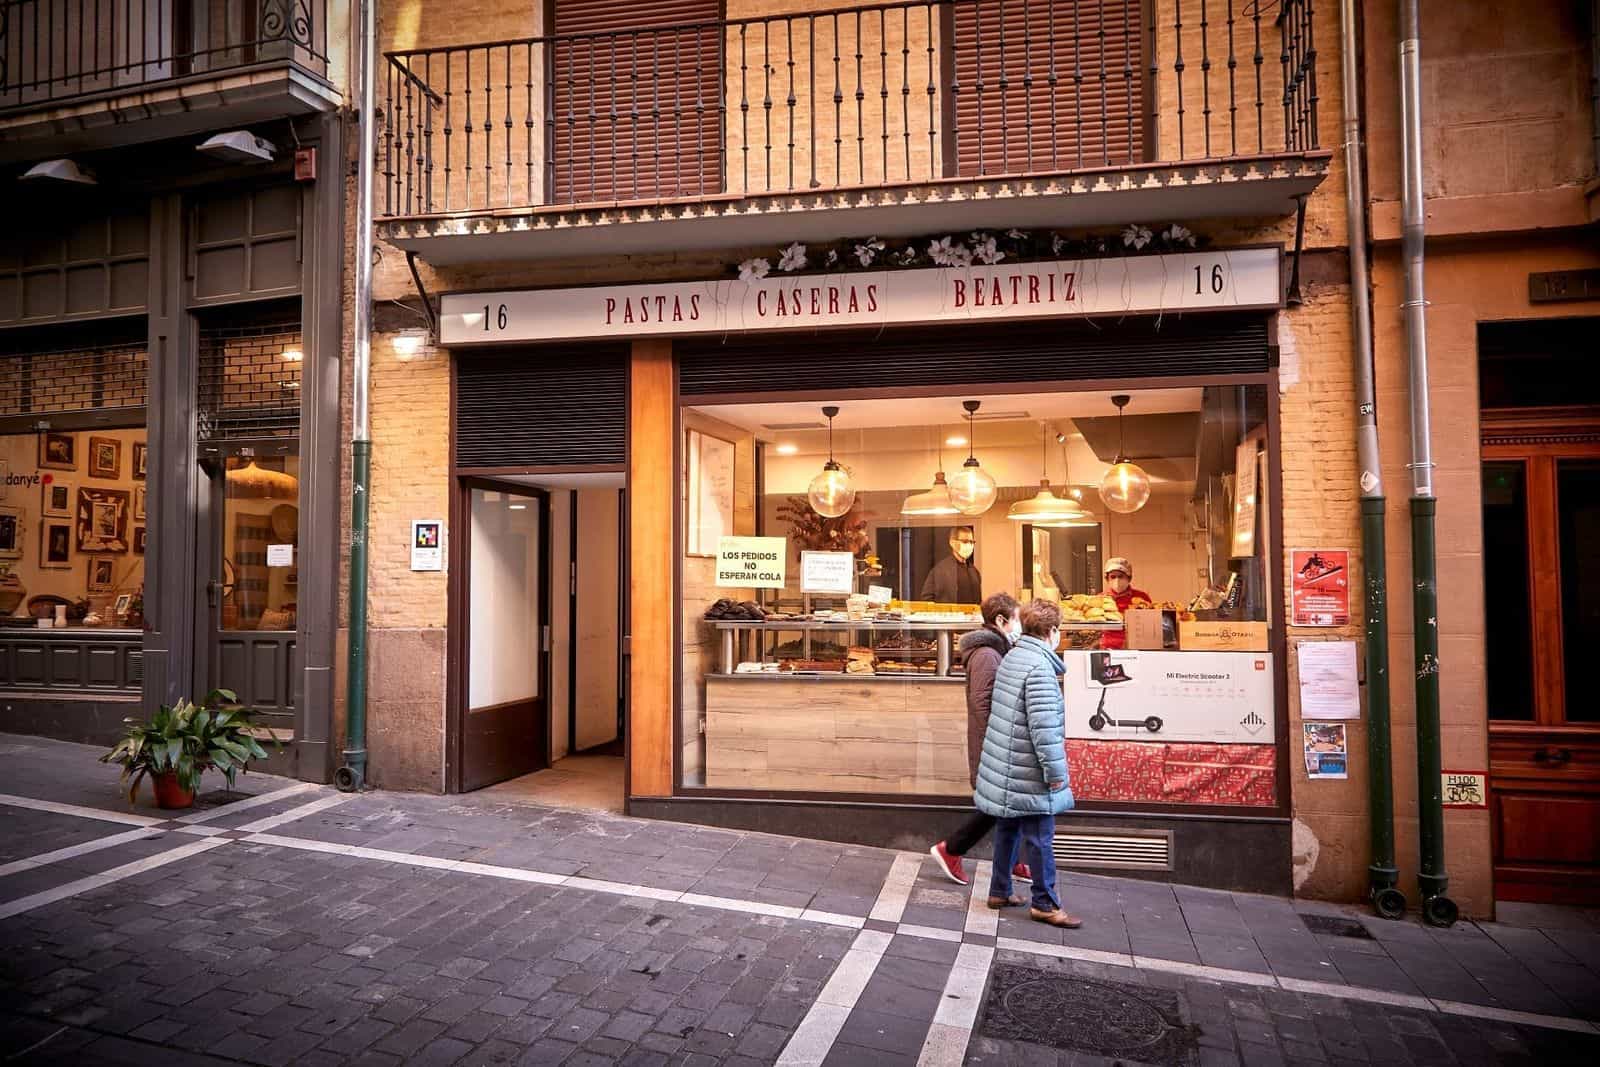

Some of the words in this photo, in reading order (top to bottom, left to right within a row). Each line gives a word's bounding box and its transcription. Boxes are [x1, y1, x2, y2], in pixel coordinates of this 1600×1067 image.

[483, 304, 508, 331] 16
[605, 294, 701, 325] PASTAS
[757, 285, 878, 317] CASERAS
[953, 272, 1076, 308] BEATRIZ
[1194, 263, 1224, 296] 16
[722, 551, 740, 560] LOS
[741, 552, 777, 561] PEDIDOS
[744, 562, 757, 570] NO
[719, 571, 757, 581] ESPERAN
[758, 572, 781, 580] COLA
[1166, 672, 1175, 680] Mi
[1175, 672, 1199, 680] Electric
[1448, 775, 1476, 785] H100
